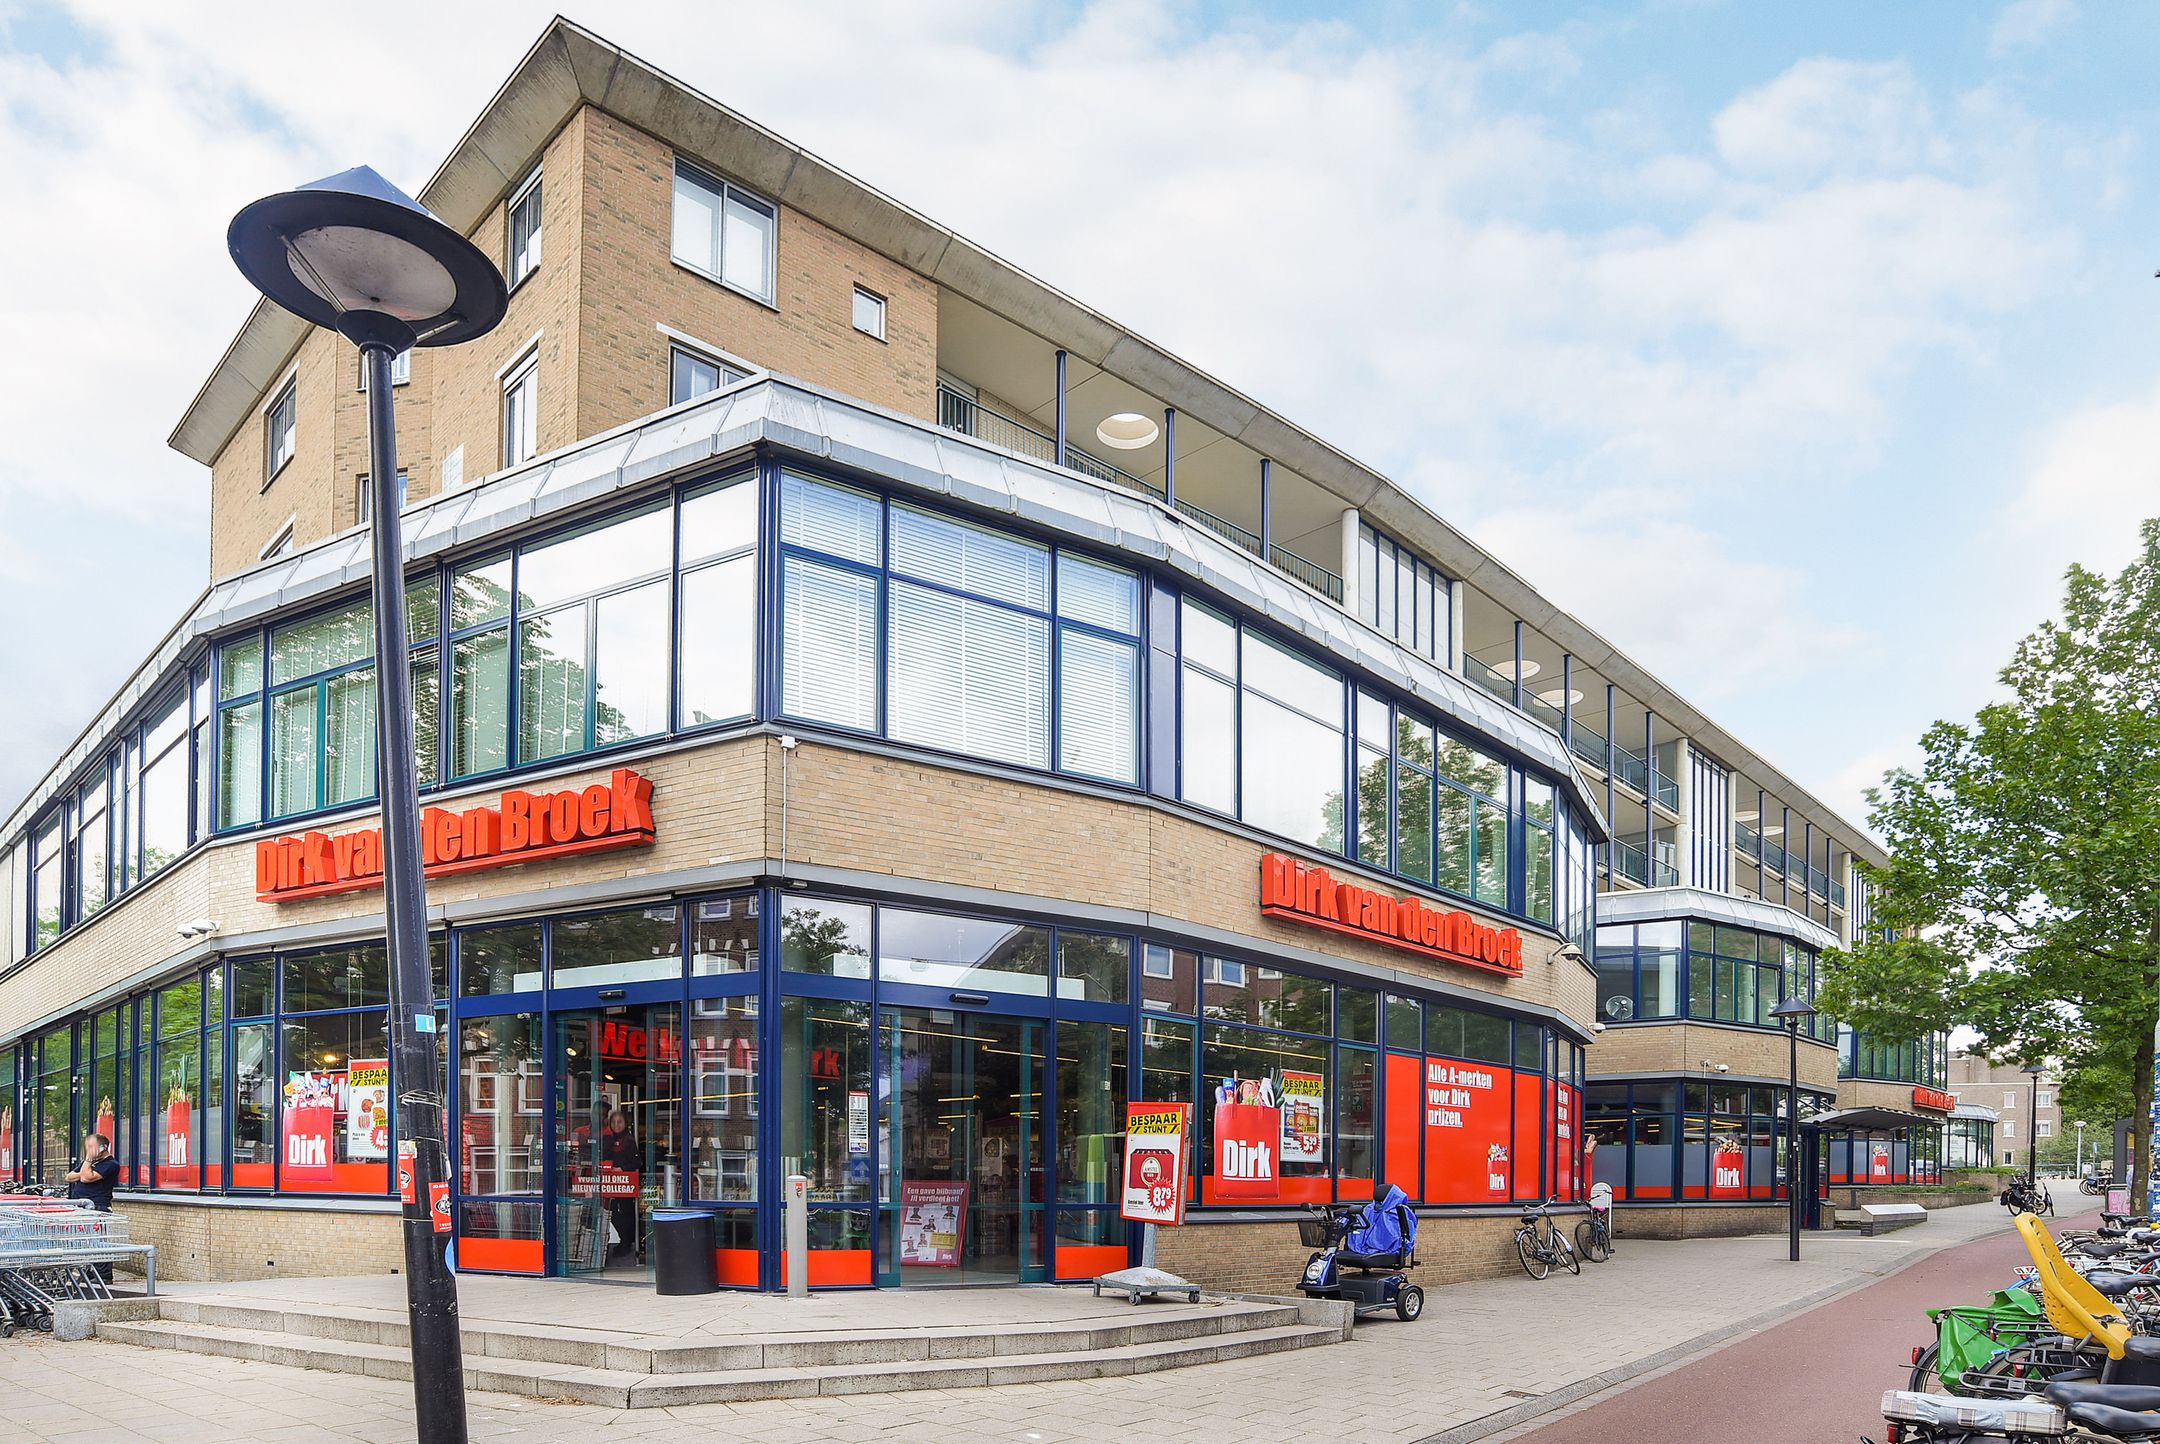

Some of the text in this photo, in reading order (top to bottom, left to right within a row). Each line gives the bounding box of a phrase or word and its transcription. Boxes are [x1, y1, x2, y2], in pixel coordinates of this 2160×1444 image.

[256, 831, 337, 893] Dirk
[333, 828, 384, 880] va
[500, 768, 654, 851] Broek
[1262, 852, 1523, 970] Dirk van den Broek
[1284, 1080, 1319, 1089] BESPAAR
[1428, 1063, 1492, 1088] Alle A-merken
[1294, 1088, 1312, 1096] STUNT
[1428, 1088, 1470, 1106] voor Dirk
[1131, 1113, 1177, 1127] BESPAAR
[1428, 1108, 1463, 1127] prijzen.
[1143, 1126, 1167, 1134] STUNT
[169, 1133, 187, 1165] Dirk
[288, 1134, 327, 1165] Dirk
[1222, 1139, 1272, 1178] Dirk
[612, 1175, 629, 1184] ONZE
[1489, 1173, 1505, 1190] Dirk
[1716, 1167, 1740, 1187] Dirk
[572, 1184, 635, 1194] NIEUWE COLLEGA?
